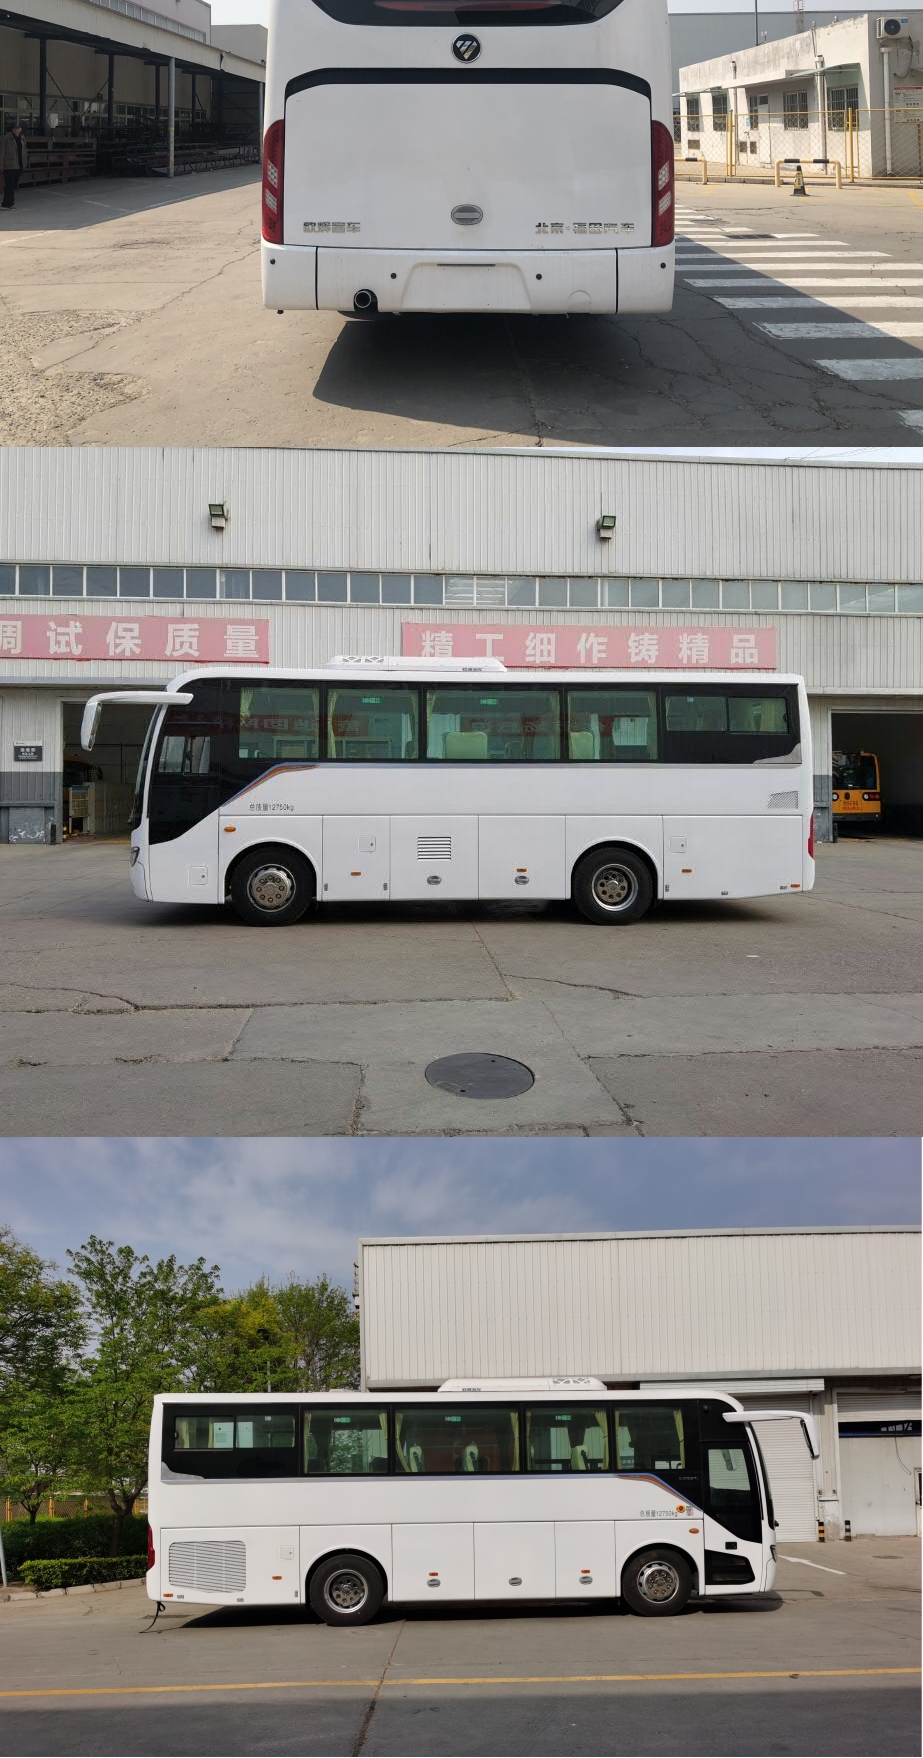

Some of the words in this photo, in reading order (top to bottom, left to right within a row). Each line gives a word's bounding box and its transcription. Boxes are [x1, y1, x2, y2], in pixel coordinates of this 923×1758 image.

[421, 631, 759, 665] 精工细作铸精品
[640, 1509, 678, 1518] 总质量12750kg
